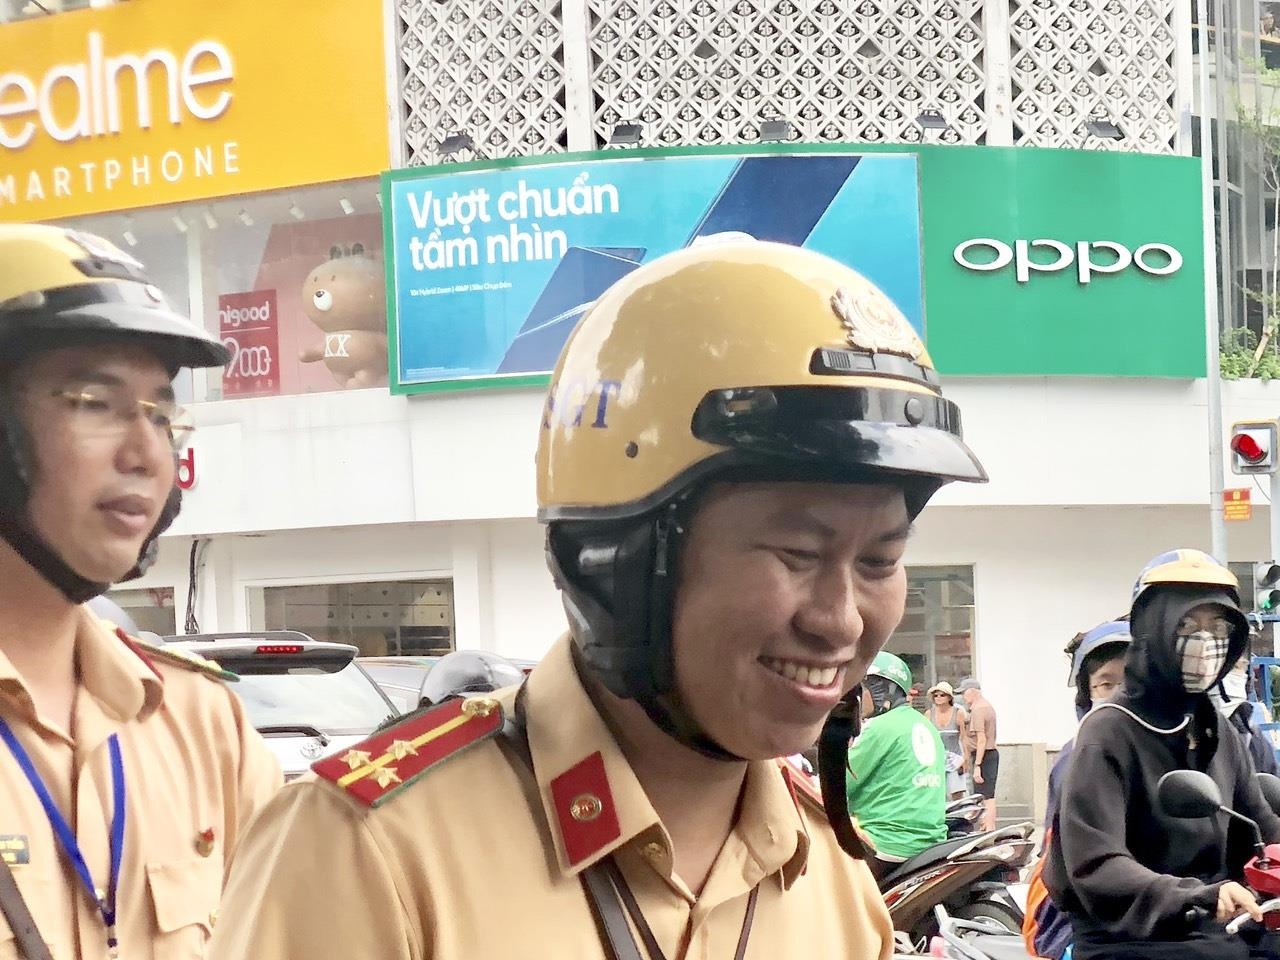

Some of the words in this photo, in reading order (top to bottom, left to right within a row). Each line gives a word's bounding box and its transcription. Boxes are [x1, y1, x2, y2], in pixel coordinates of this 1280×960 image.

[0, 31, 234, 150] ealme
[406, 188, 492, 235] Vượt
[497, 171, 620, 221] chuẩn
[409, 228, 479, 272] tầm
[486, 223, 568, 264] nhìn
